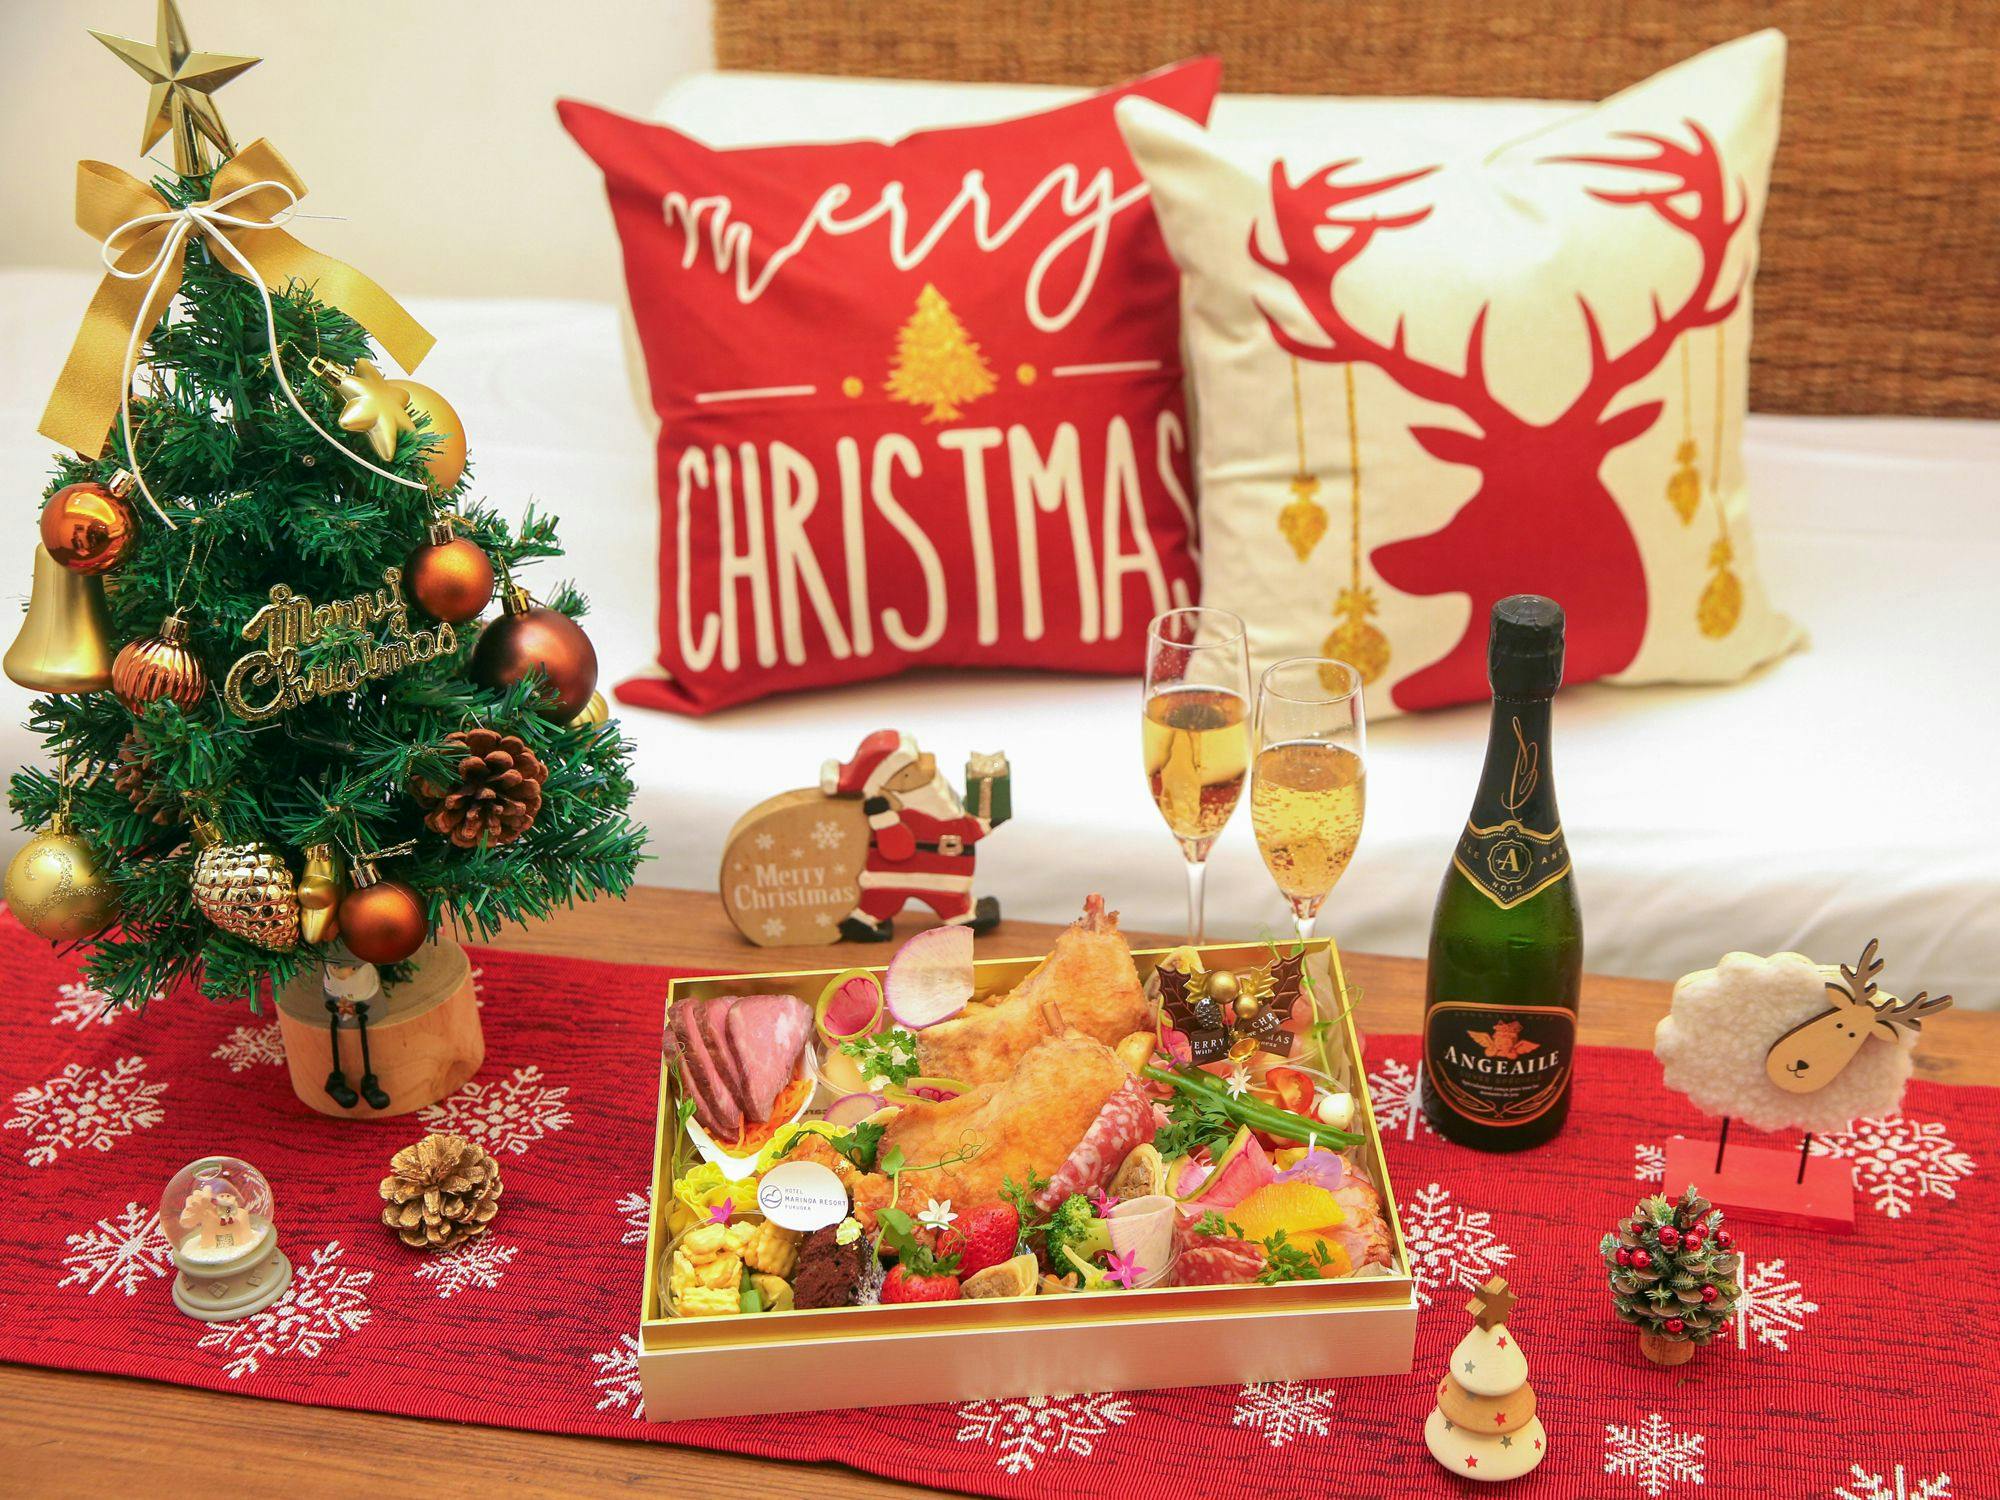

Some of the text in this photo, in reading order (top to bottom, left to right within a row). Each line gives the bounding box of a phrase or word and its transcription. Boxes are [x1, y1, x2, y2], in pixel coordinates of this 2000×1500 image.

[677, 411, 1200, 672] CHRISTMAS
[224, 622, 458, 721] Christmas
[755, 863, 825, 888] Merry
[734, 884, 856, 910] Christmas
[1191, 1038, 1225, 1049] ERRY
[1444, 1046, 1560, 1075] ANGEAILE
